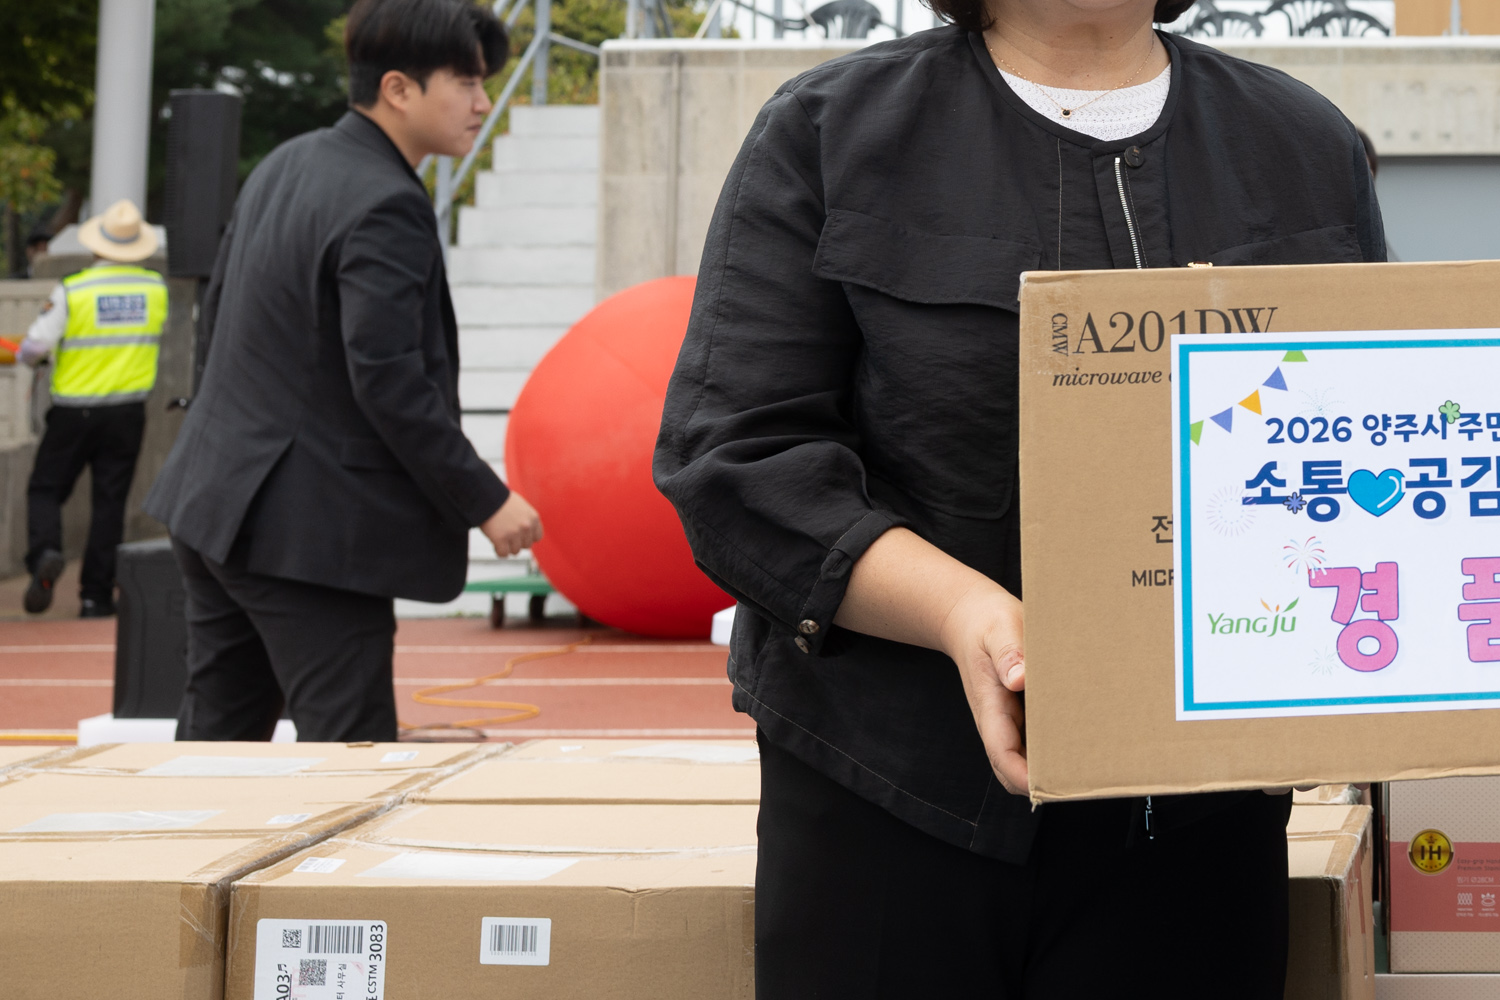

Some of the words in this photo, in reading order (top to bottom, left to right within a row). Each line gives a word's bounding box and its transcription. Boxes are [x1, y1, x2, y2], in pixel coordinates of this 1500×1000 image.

[1051, 312, 1069, 357] CMW
[1052, 366, 1163, 388] microwave
[1265, 415, 1353, 445] 2026
[1362, 412, 1448, 446] 양주시
[1241, 459, 1349, 522] 소통
[1207, 597, 1300, 637] Yangju
[368, 924, 384, 962] 3083
[337, 963, 348, 989] 사무실
[367, 964, 378, 994] CSTM
